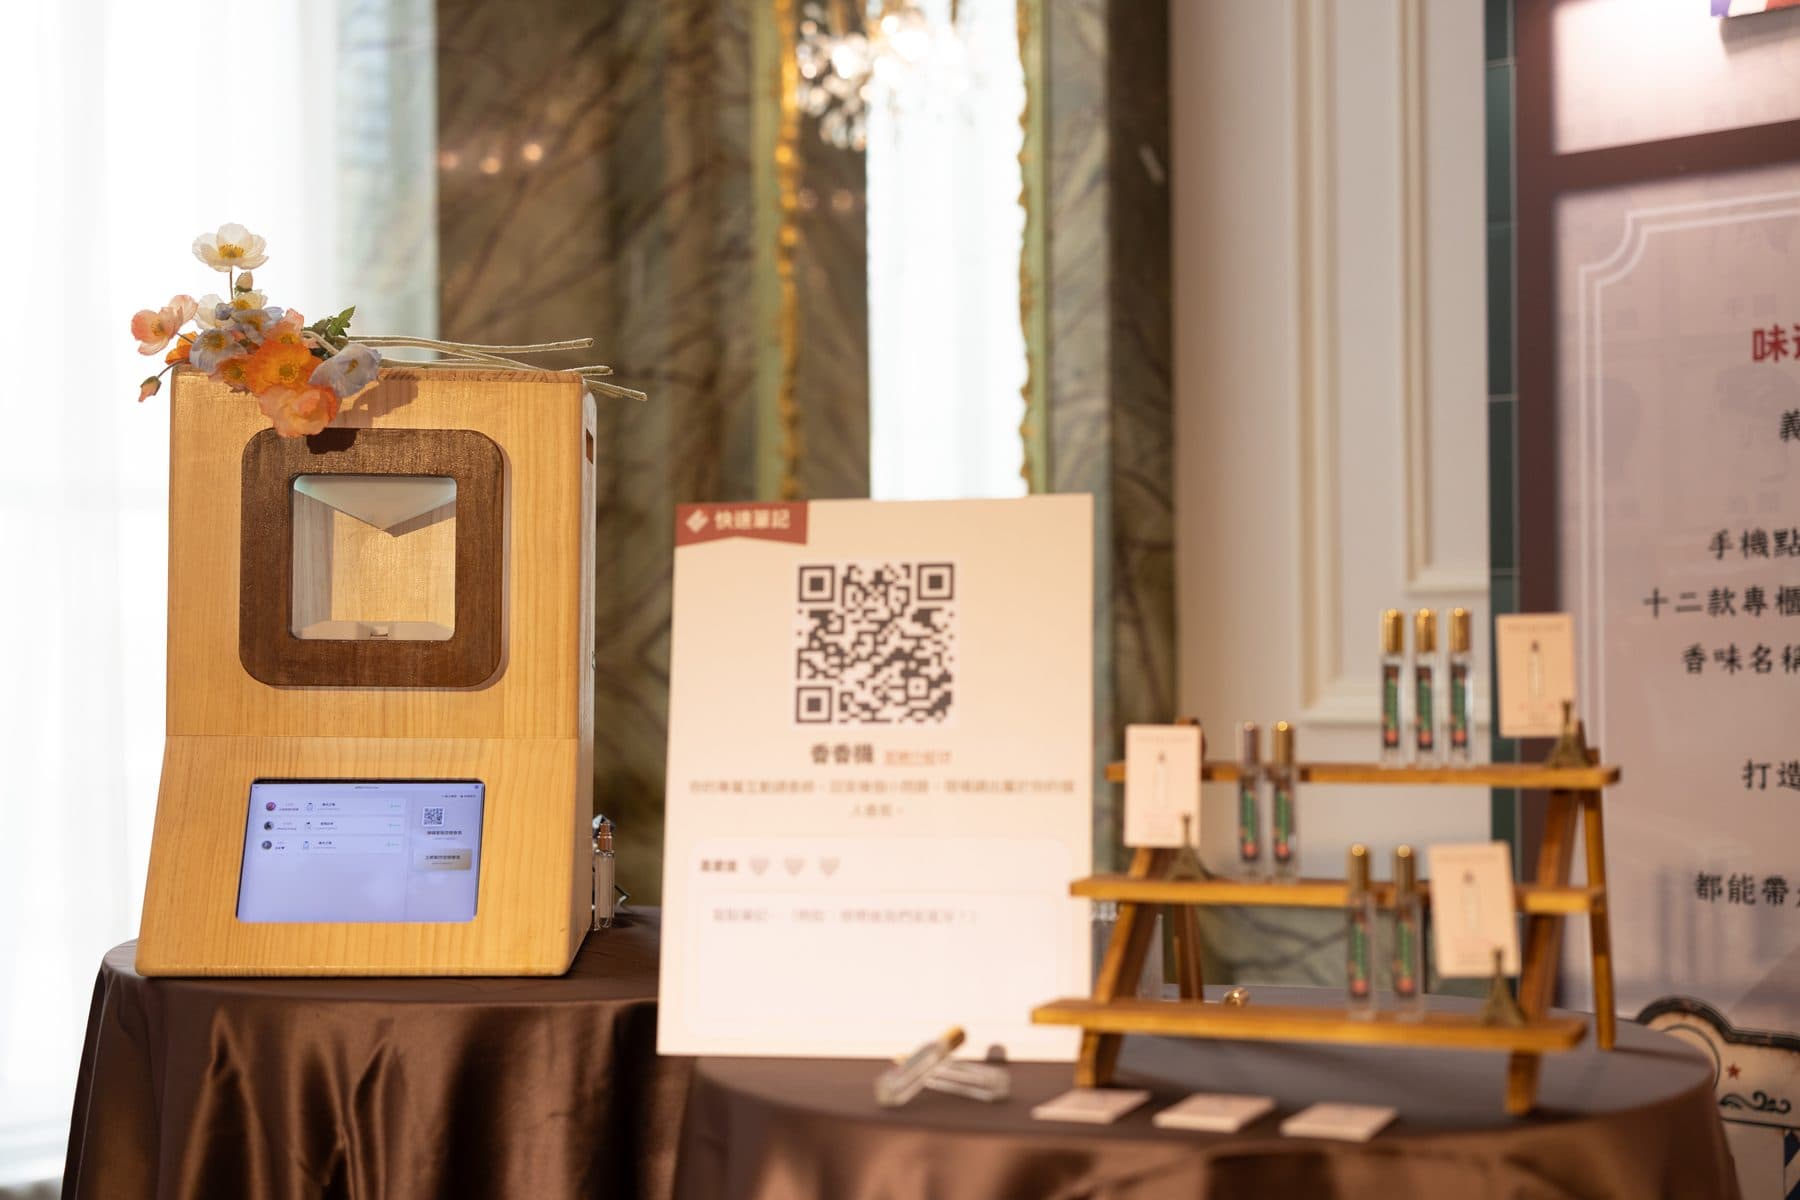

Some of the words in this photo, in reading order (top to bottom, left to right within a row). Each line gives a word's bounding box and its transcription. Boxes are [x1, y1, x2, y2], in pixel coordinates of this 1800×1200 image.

[1708, 529, 1800, 560] 手機點
[1643, 585, 1800, 619] 十二款專櫃
[1742, 758, 1800, 791] 打造
[1696, 870, 1800, 906] 都能帶
